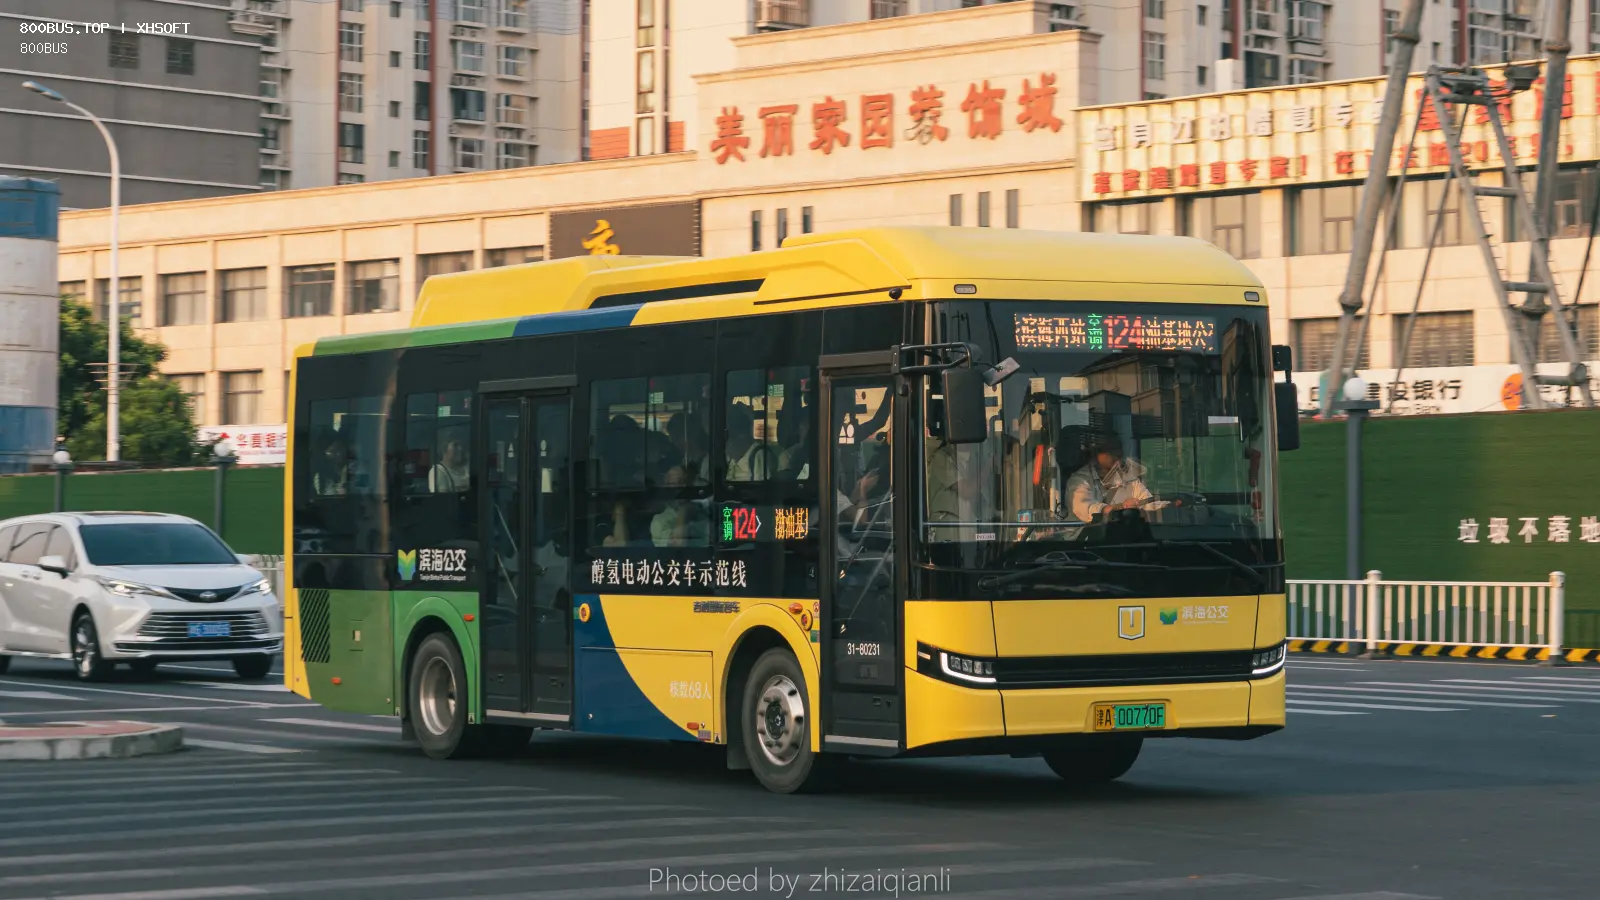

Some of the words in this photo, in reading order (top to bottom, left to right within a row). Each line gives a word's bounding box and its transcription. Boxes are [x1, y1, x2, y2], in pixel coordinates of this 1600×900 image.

[710, 72, 1064, 165] 美丽家园装饰城
[1103, 315, 1142, 350] 124
[723, 507, 733, 541] 空调
[732, 507, 757, 540] 124
[775, 507, 809, 540] 渤油基
[1457, 515, 1600, 544] 垃圾不落地
[419, 548, 467, 572] 滨海公交
[591, 558, 748, 588] 醇氢电动公交车示范线
[1182, 605, 1229, 619] 滨海公交
[847, 642, 881, 656] 31-80231
[669, 680, 711, 699] 核载68人
